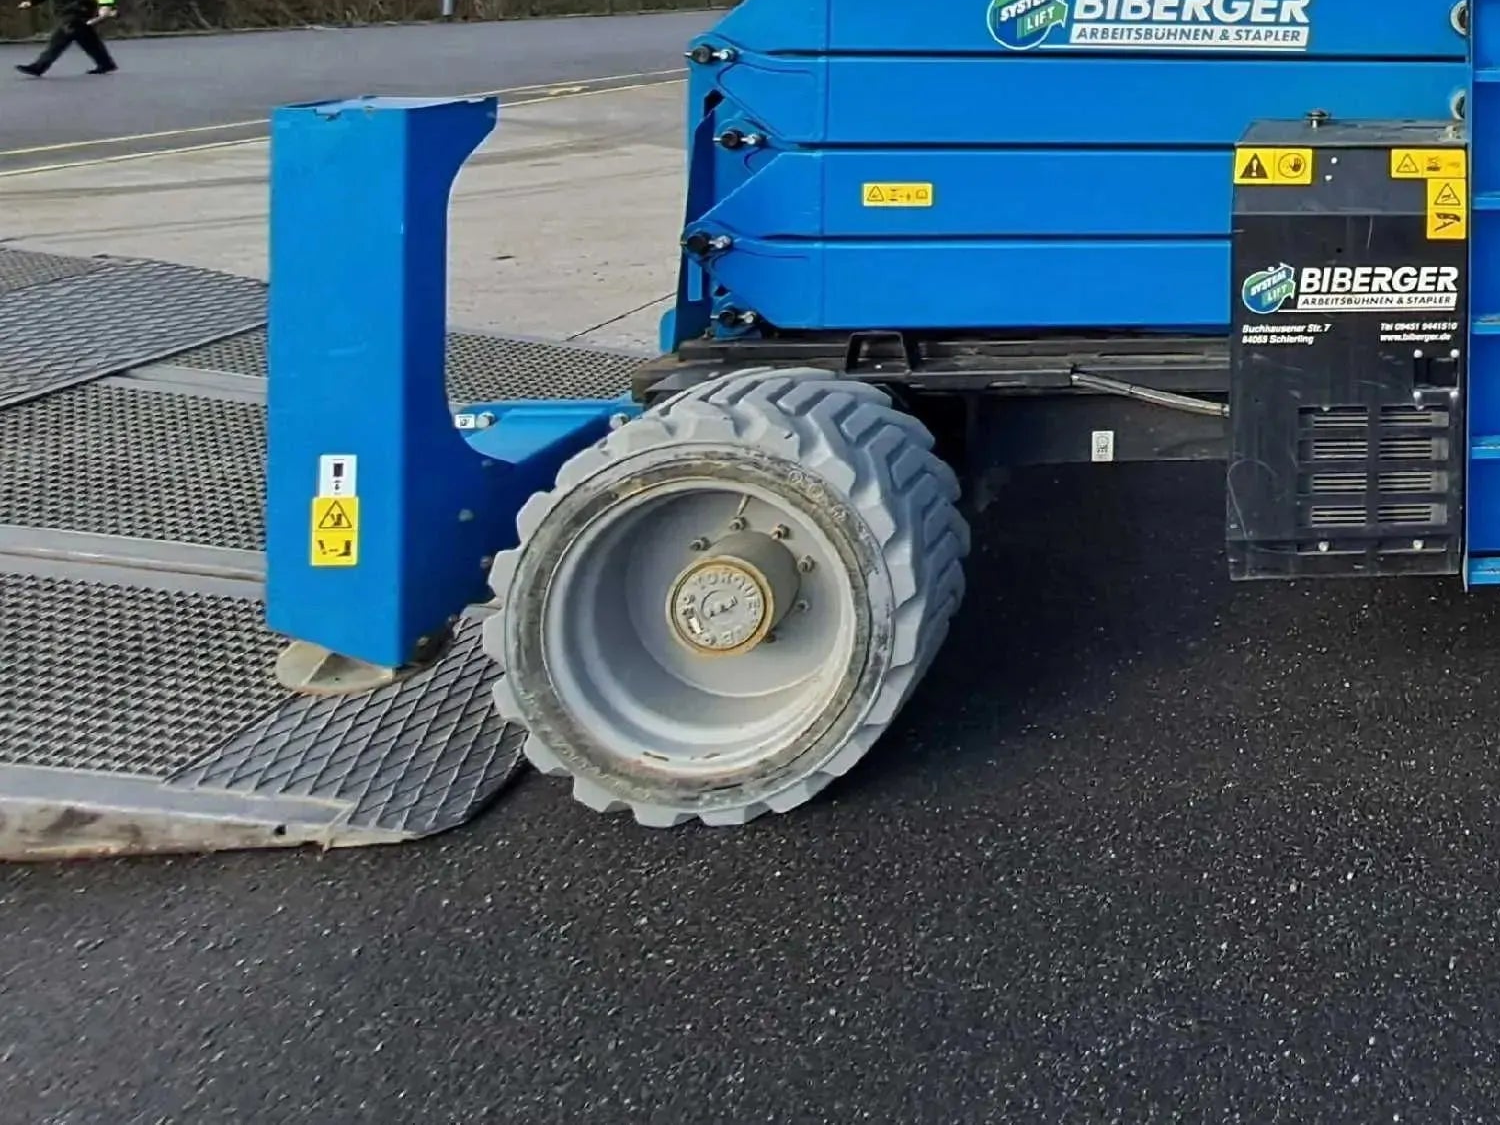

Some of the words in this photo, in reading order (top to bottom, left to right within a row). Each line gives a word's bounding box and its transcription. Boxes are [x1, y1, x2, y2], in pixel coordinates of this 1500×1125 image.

[1027, 5, 1055, 30] LIFT
[1076, 26, 1216, 42] ARBEITSBÜHNEN
[1219, 28, 1230, 41] &
[1233, 28, 1300, 43] STAPLER
[1300, 266, 1459, 293] BIBERGER
[1406, 296, 1452, 305] STAPLER
